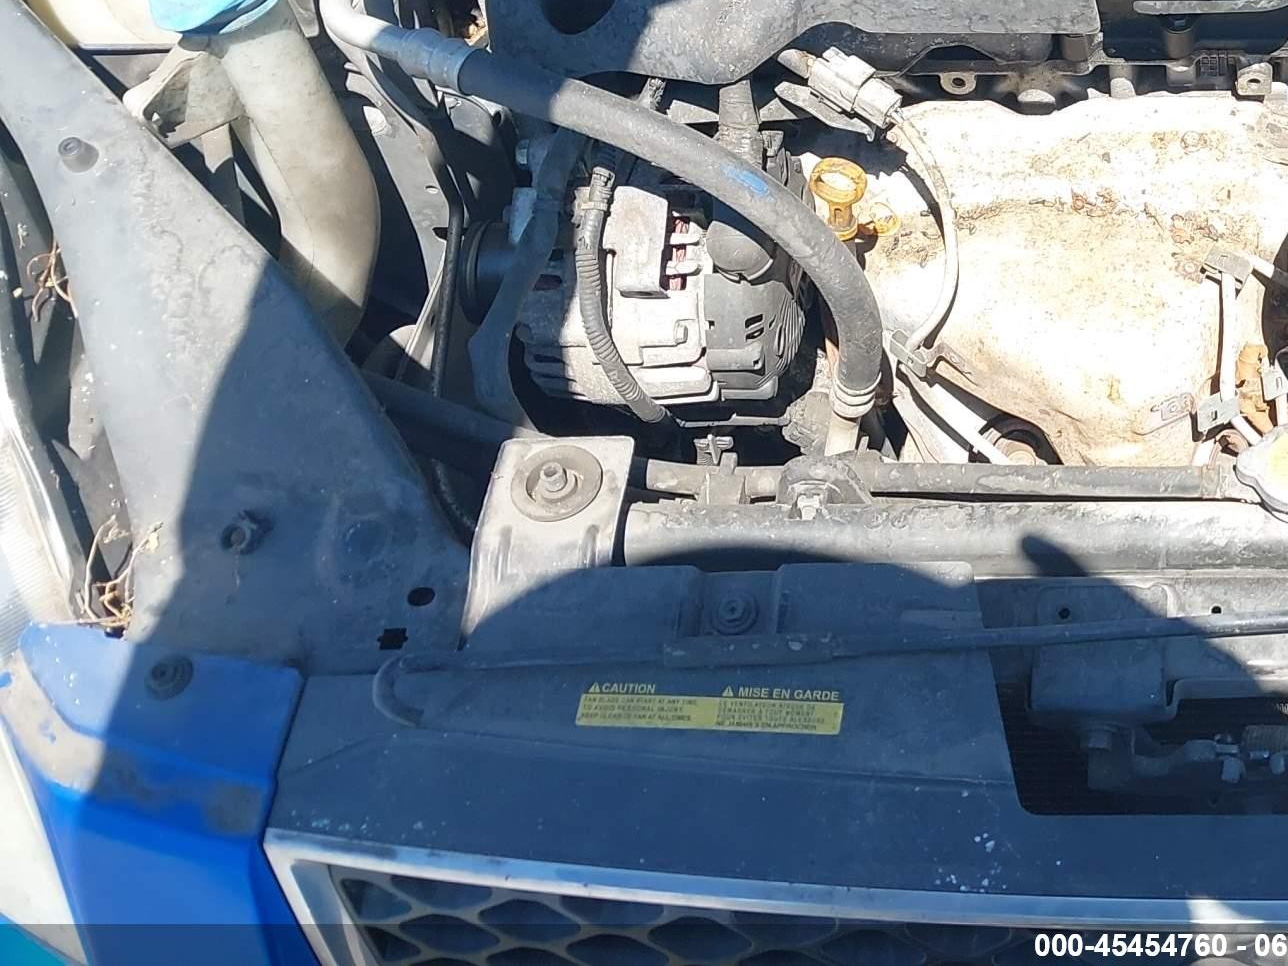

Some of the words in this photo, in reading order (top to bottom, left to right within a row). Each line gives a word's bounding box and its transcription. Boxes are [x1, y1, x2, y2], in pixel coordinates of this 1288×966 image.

[601, 683, 657, 695] CAUTION
[738, 686, 769, 699] MISE
[772, 688, 792, 700] EN
[793, 689, 841, 701] GARDE
